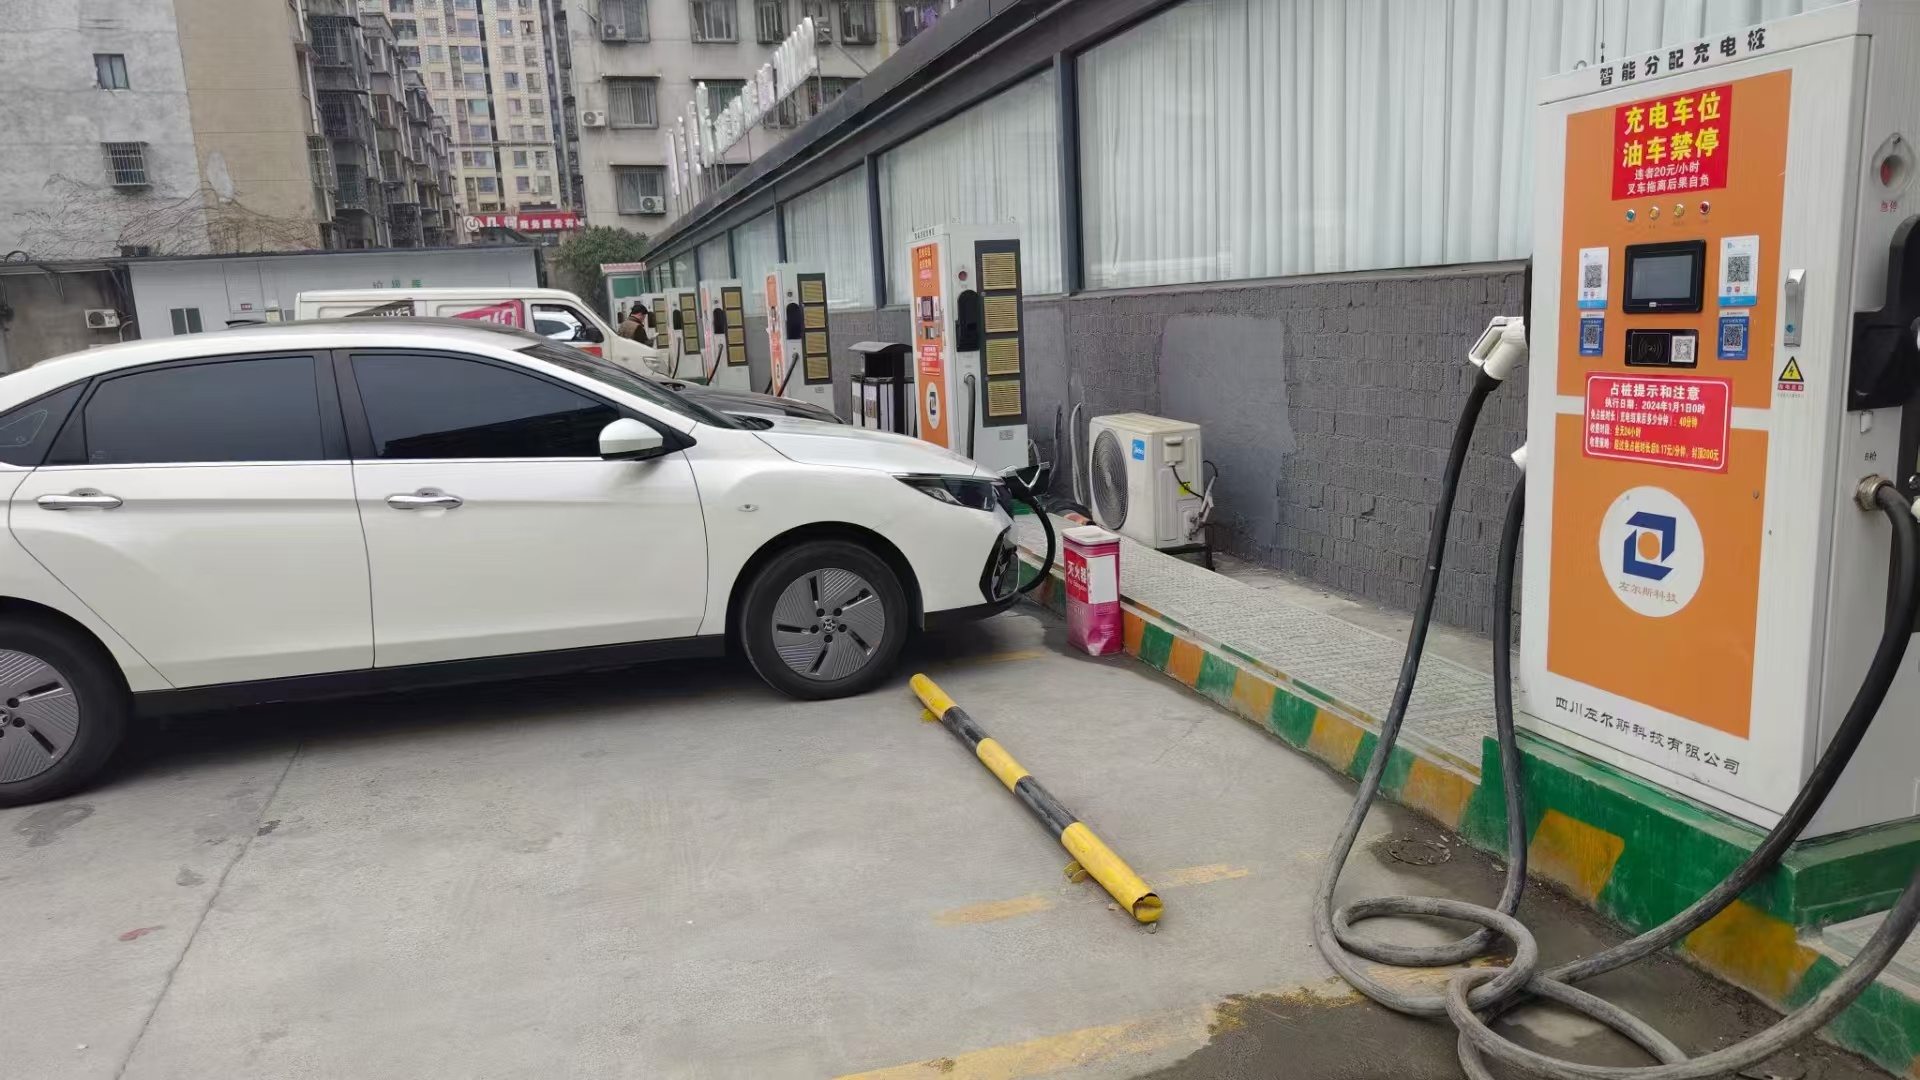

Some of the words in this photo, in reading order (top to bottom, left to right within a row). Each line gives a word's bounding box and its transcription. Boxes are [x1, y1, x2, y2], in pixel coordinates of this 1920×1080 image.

[1600, 28, 1766, 86] 智能分配充电桩
[1624, 91, 1720, 135] 充电车位
[1622, 127, 1719, 168] 油车禁停
[1627, 174, 1709, 195] 叉车拖离后果自负
[1634, 161, 1700, 180] 违者20元/小时
[1610, 382, 1700, 401] 占桩提示和注意
[1555, 696, 1740, 776] 四川左尔斯科技有限公司
